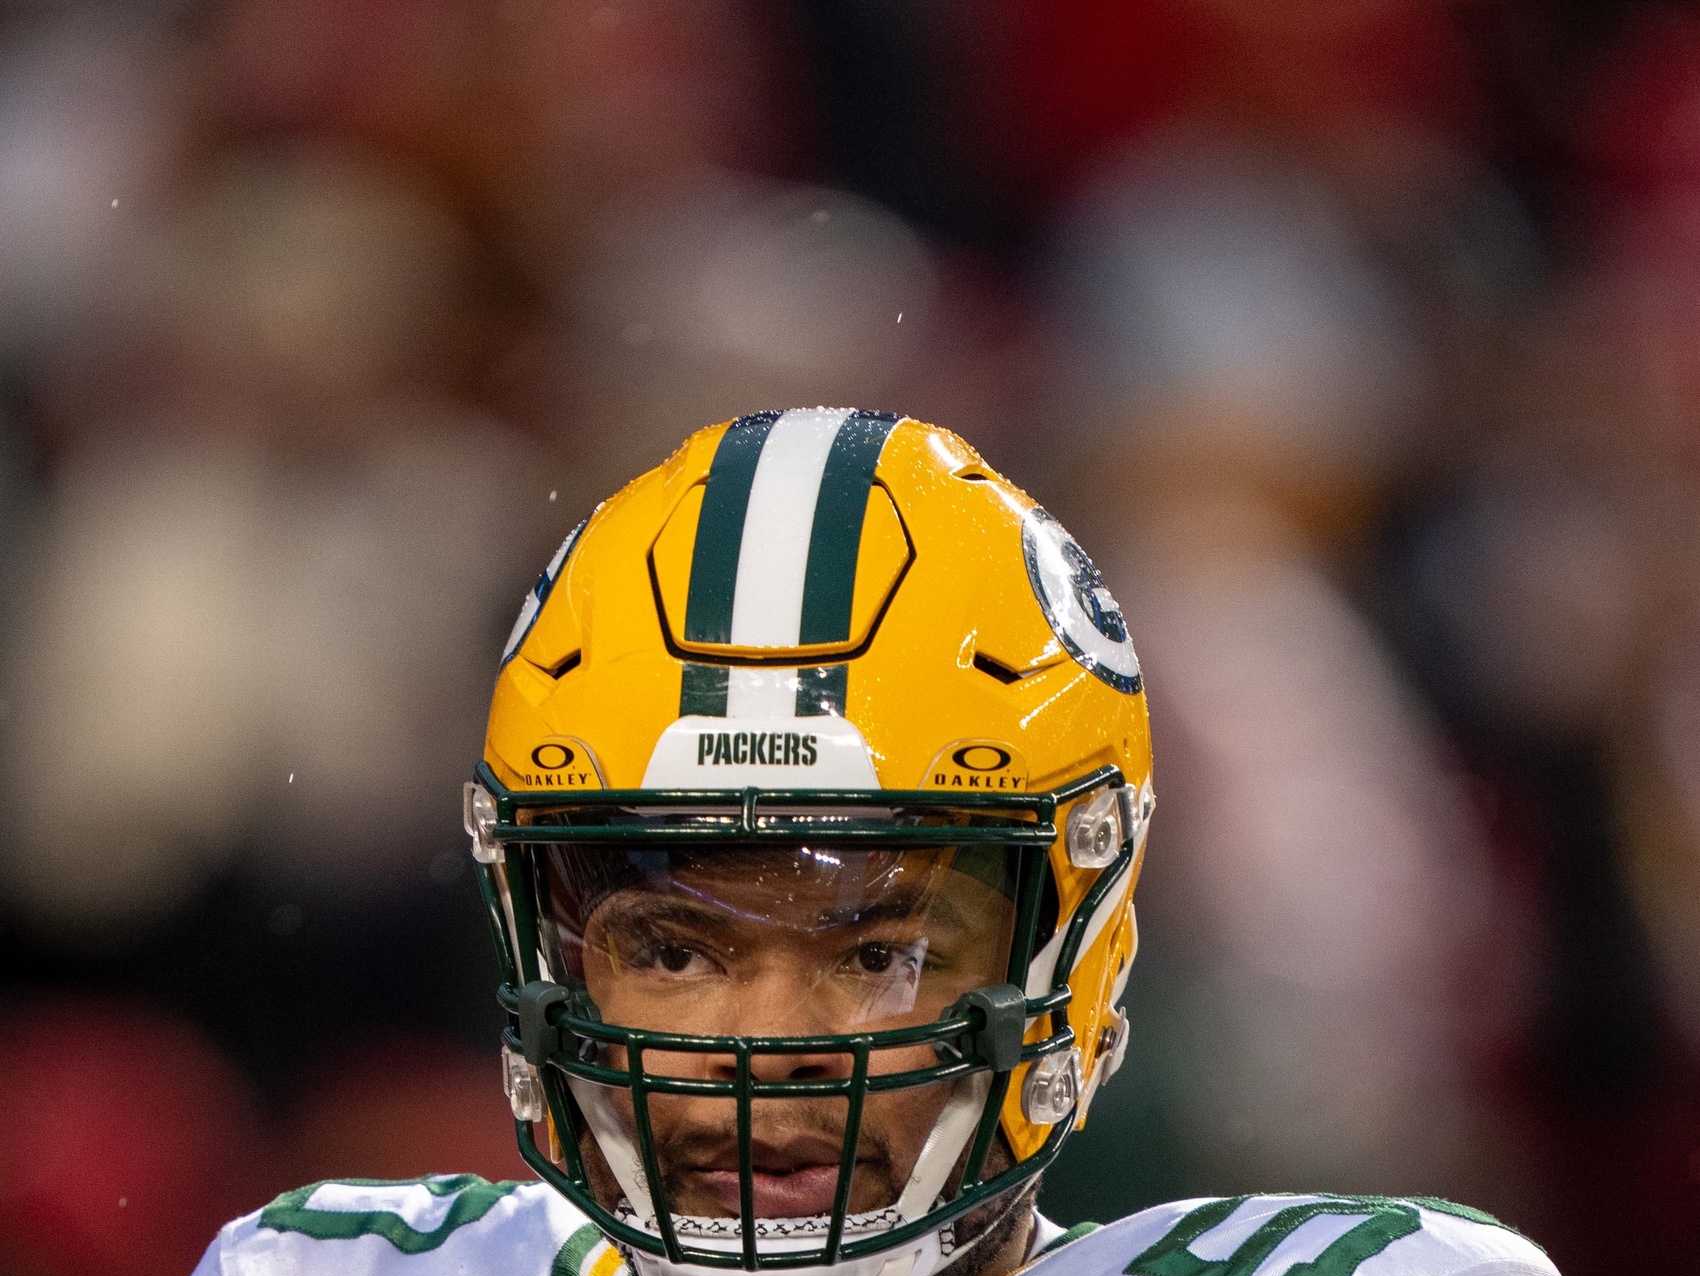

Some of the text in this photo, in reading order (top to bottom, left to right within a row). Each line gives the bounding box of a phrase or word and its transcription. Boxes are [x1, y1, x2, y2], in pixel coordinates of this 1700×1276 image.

[697, 732, 818, 766] PACKERS
[525, 773, 588, 786] OAKLEY
[934, 774, 1021, 789] OAKLEY
